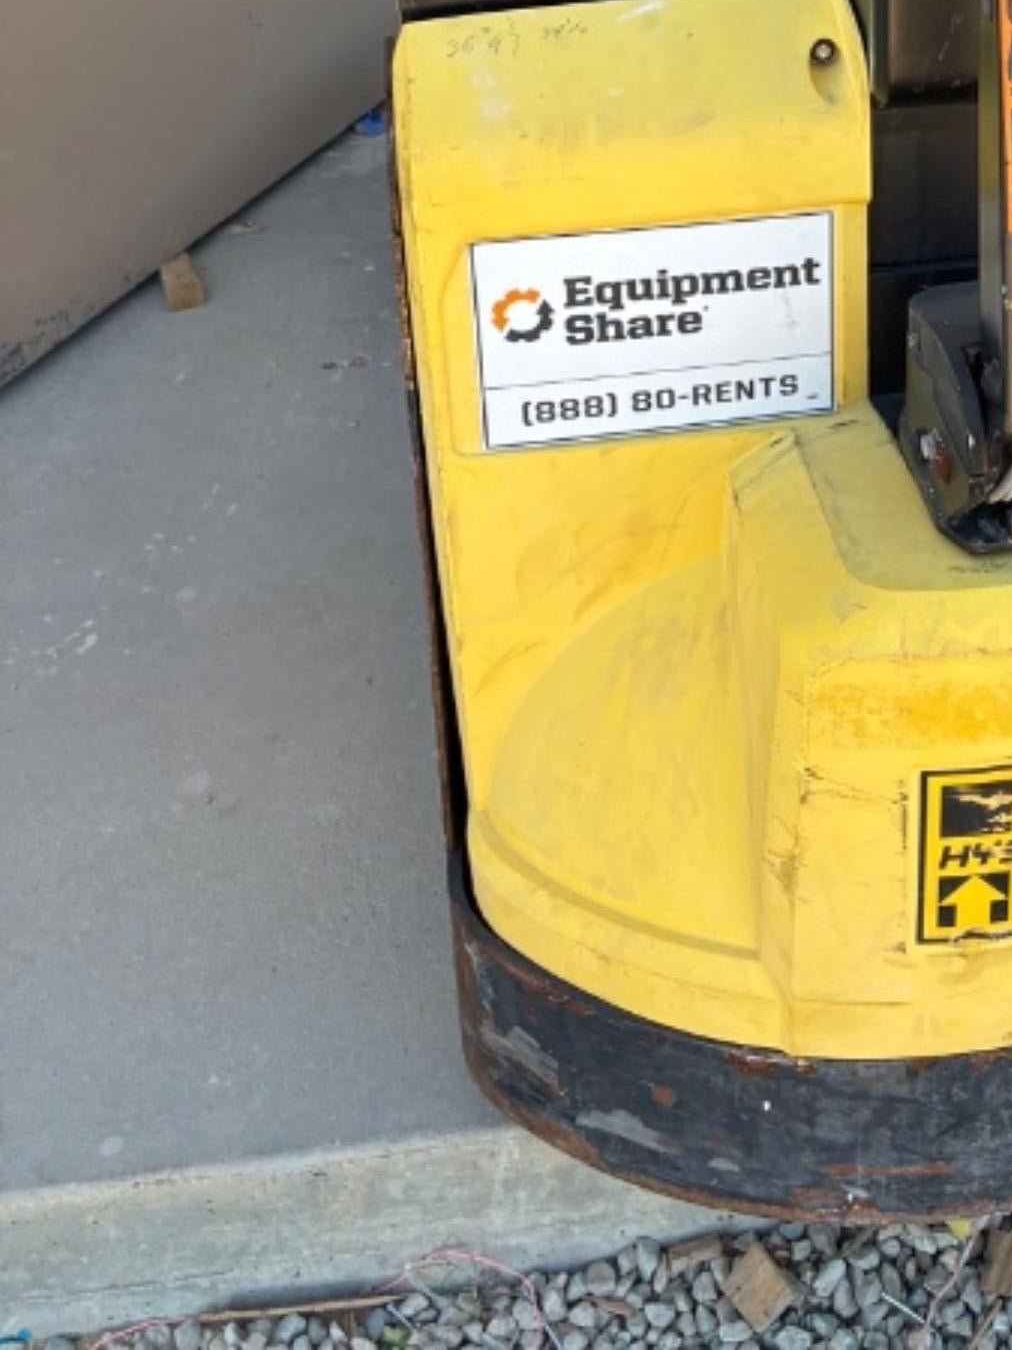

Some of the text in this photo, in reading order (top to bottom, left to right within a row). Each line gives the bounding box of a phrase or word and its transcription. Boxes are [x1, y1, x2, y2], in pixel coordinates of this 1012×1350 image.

[563, 256, 821, 311] Equipment
[564, 309, 704, 346] Share
[521, 373, 800, 428] (888) 80-RENTS
